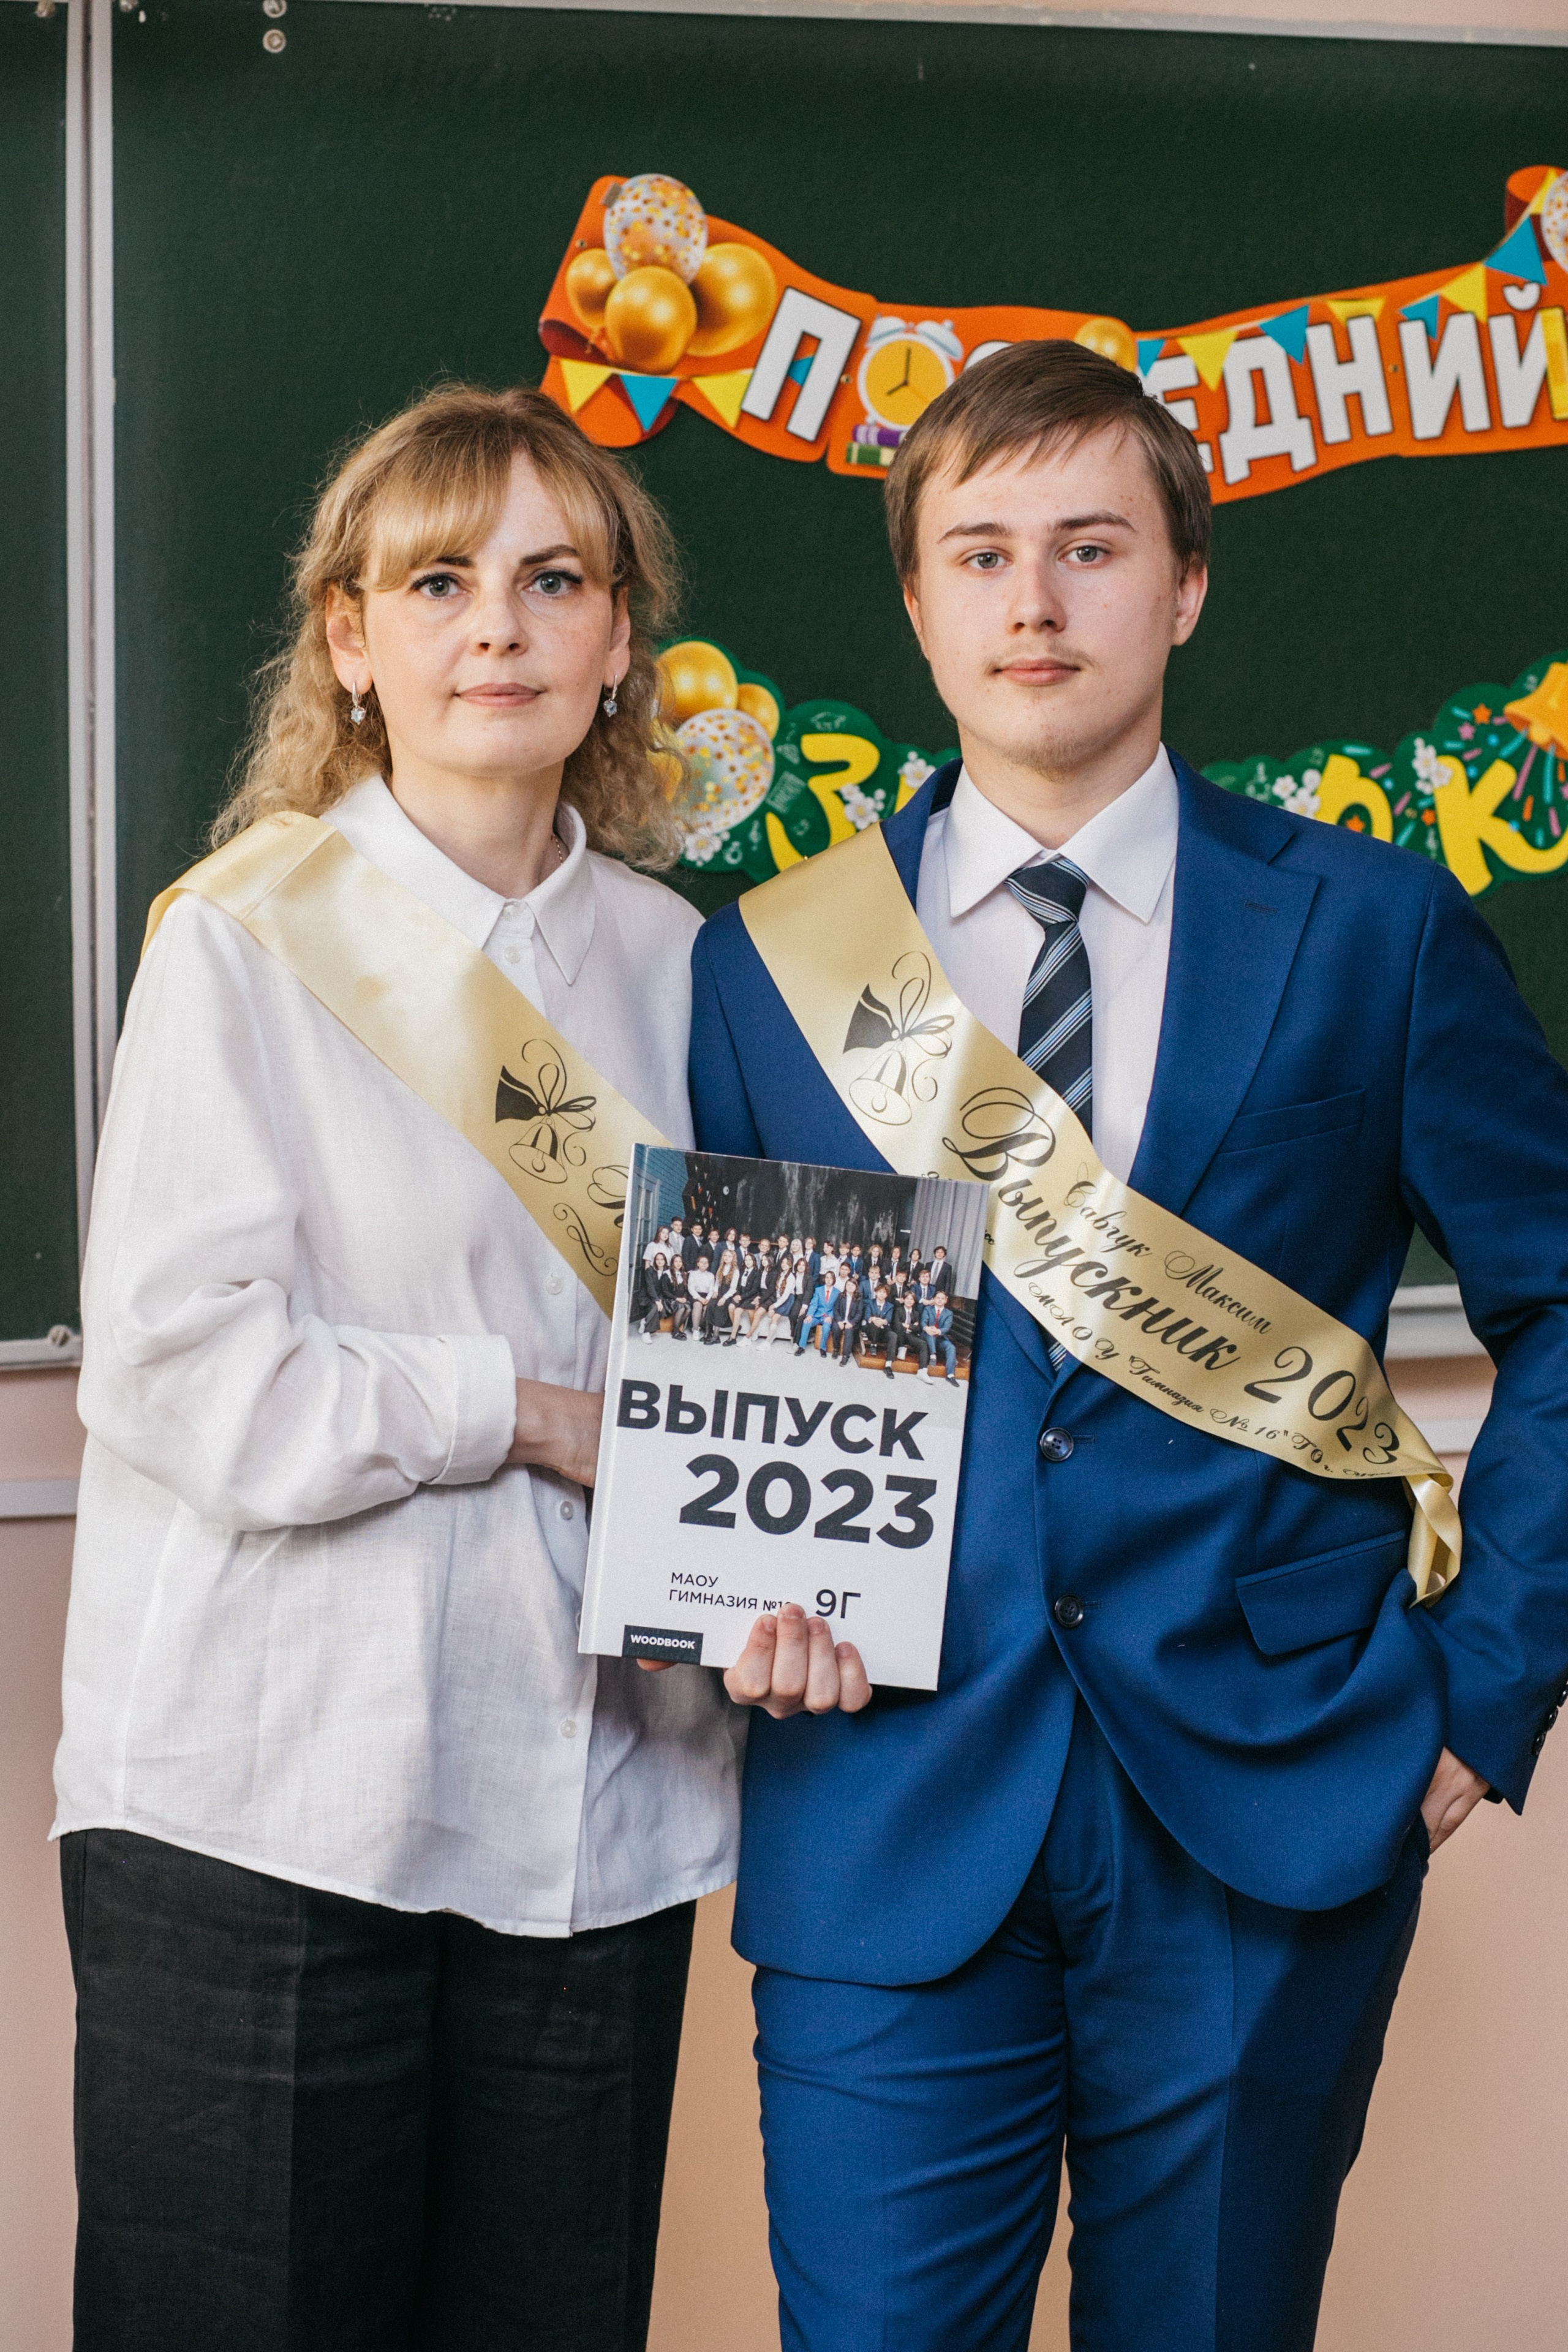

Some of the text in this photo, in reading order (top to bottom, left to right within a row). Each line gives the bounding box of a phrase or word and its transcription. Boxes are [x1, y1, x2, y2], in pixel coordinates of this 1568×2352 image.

[941, 1087, 1401, 1464] Выпускник 2023
[1164, 1250, 1273, 1335] Максим
[616, 1378, 929, 1461] ВЫПУСК
[679, 1453, 938, 1550] 2023
[669, 1589, 791, 1611] ГИМНАЗИЯ №1
[671, 1572, 718, 1588] МАОУ
[815, 1588, 862, 1619] 9Г
[630, 1634, 695, 1649] WOODBOOK
